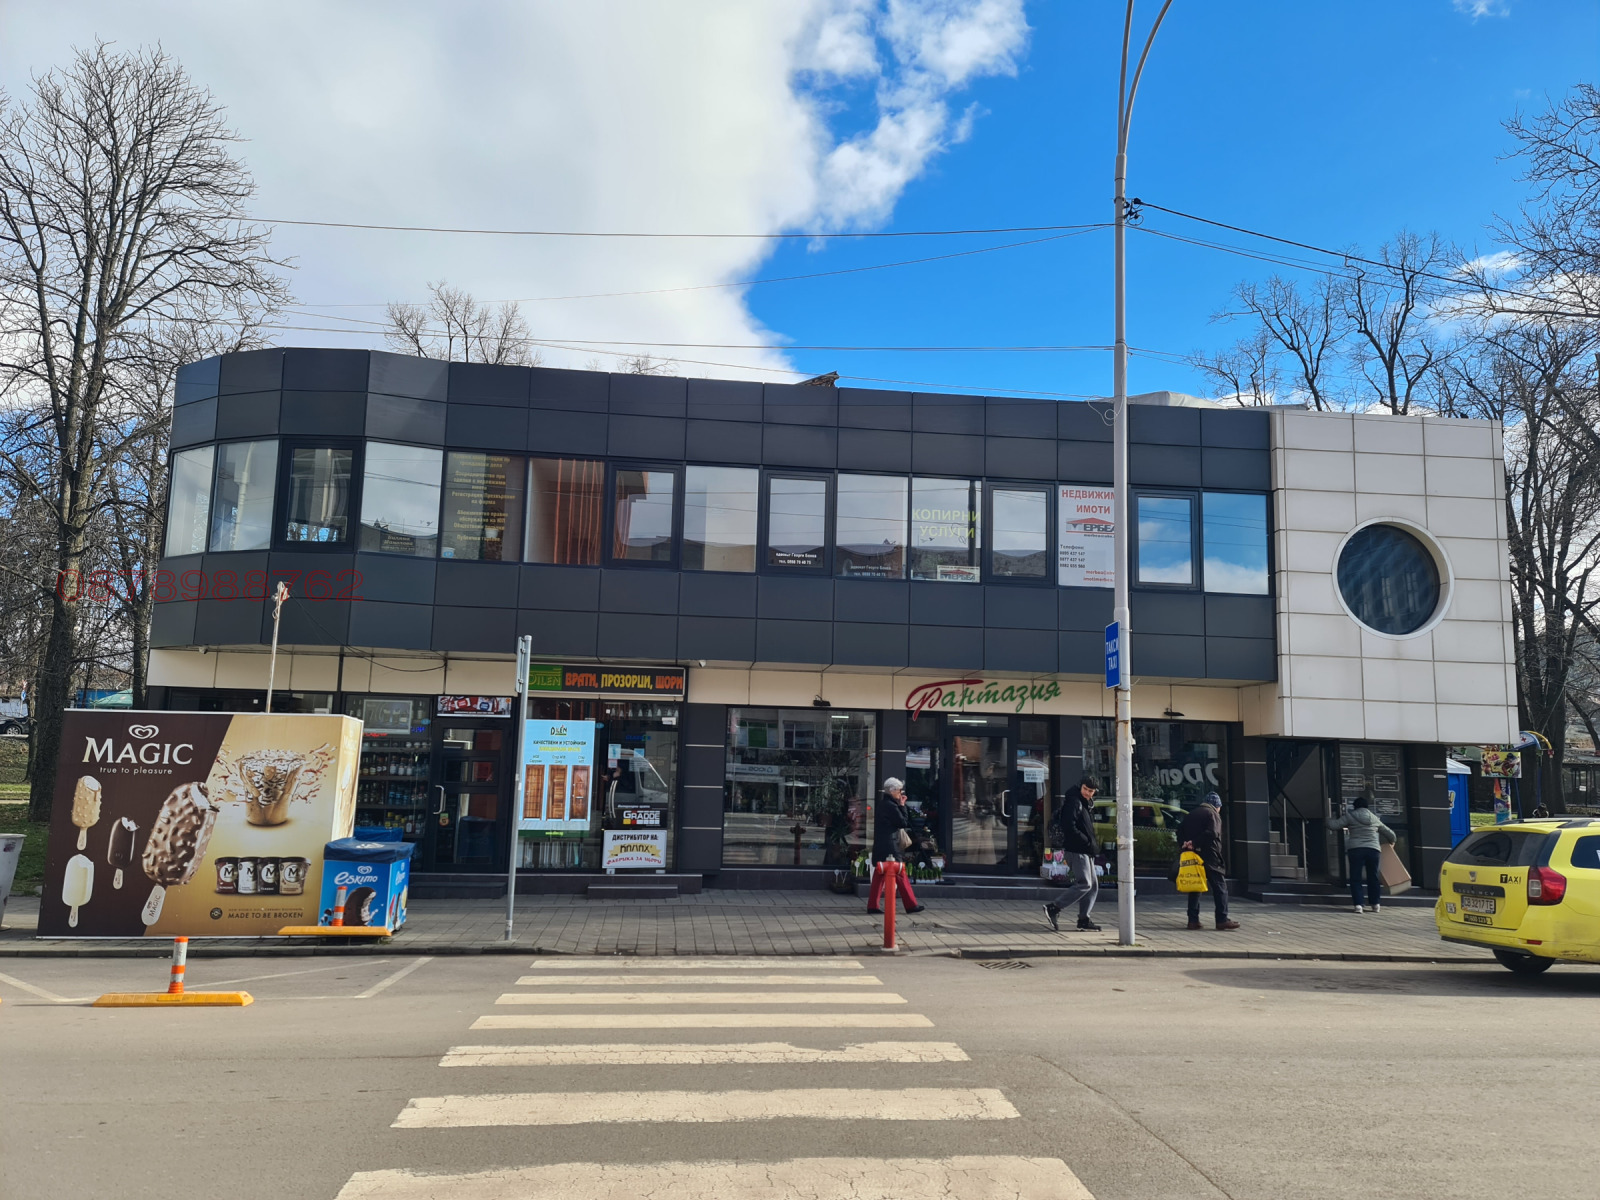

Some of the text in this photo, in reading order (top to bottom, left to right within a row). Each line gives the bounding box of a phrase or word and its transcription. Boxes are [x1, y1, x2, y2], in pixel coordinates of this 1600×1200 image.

[912, 508, 981, 521] КОПИРНИ
[1076, 504, 1111, 514] ИМОТИ
[920, 525, 975, 538] УСЛУГИ
[565, 672, 599, 688] ВРАТИ,
[601, 673, 653, 690] ПРОЗОРЦИ,
[905, 679, 1062, 721] Фантазия
[82, 736, 194, 765] MAGIC
[100, 766, 117, 774] true
[133, 766, 173, 775] pleasure
